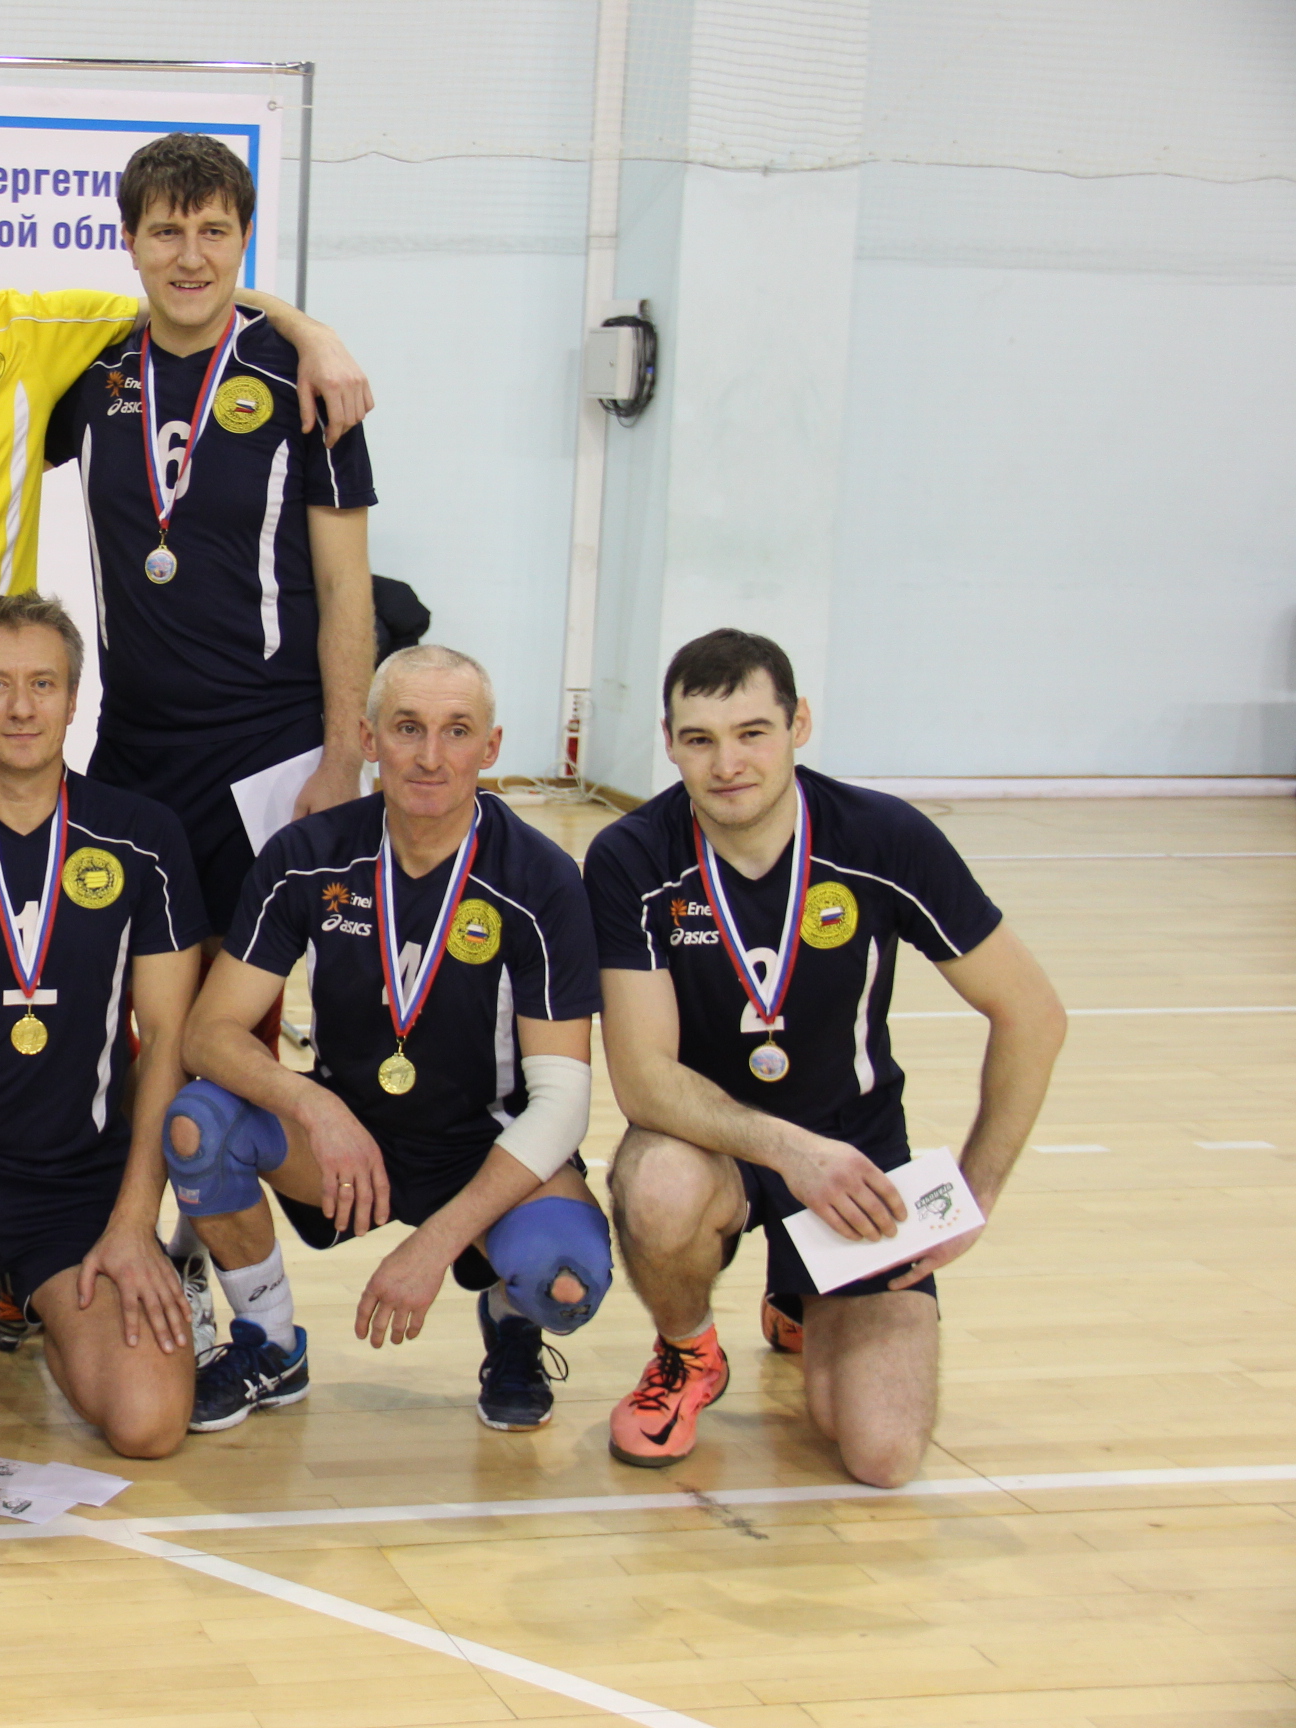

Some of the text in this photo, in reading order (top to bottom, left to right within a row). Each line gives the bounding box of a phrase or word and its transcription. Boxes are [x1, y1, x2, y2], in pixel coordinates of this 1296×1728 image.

[120, 401, 143, 414] asic
[156, 420, 193, 500] 6
[687, 901, 713, 917] Ene
[339, 919, 373, 937] asics
[683, 930, 720, 945] asics
[738, 946, 786, 1034] 2
